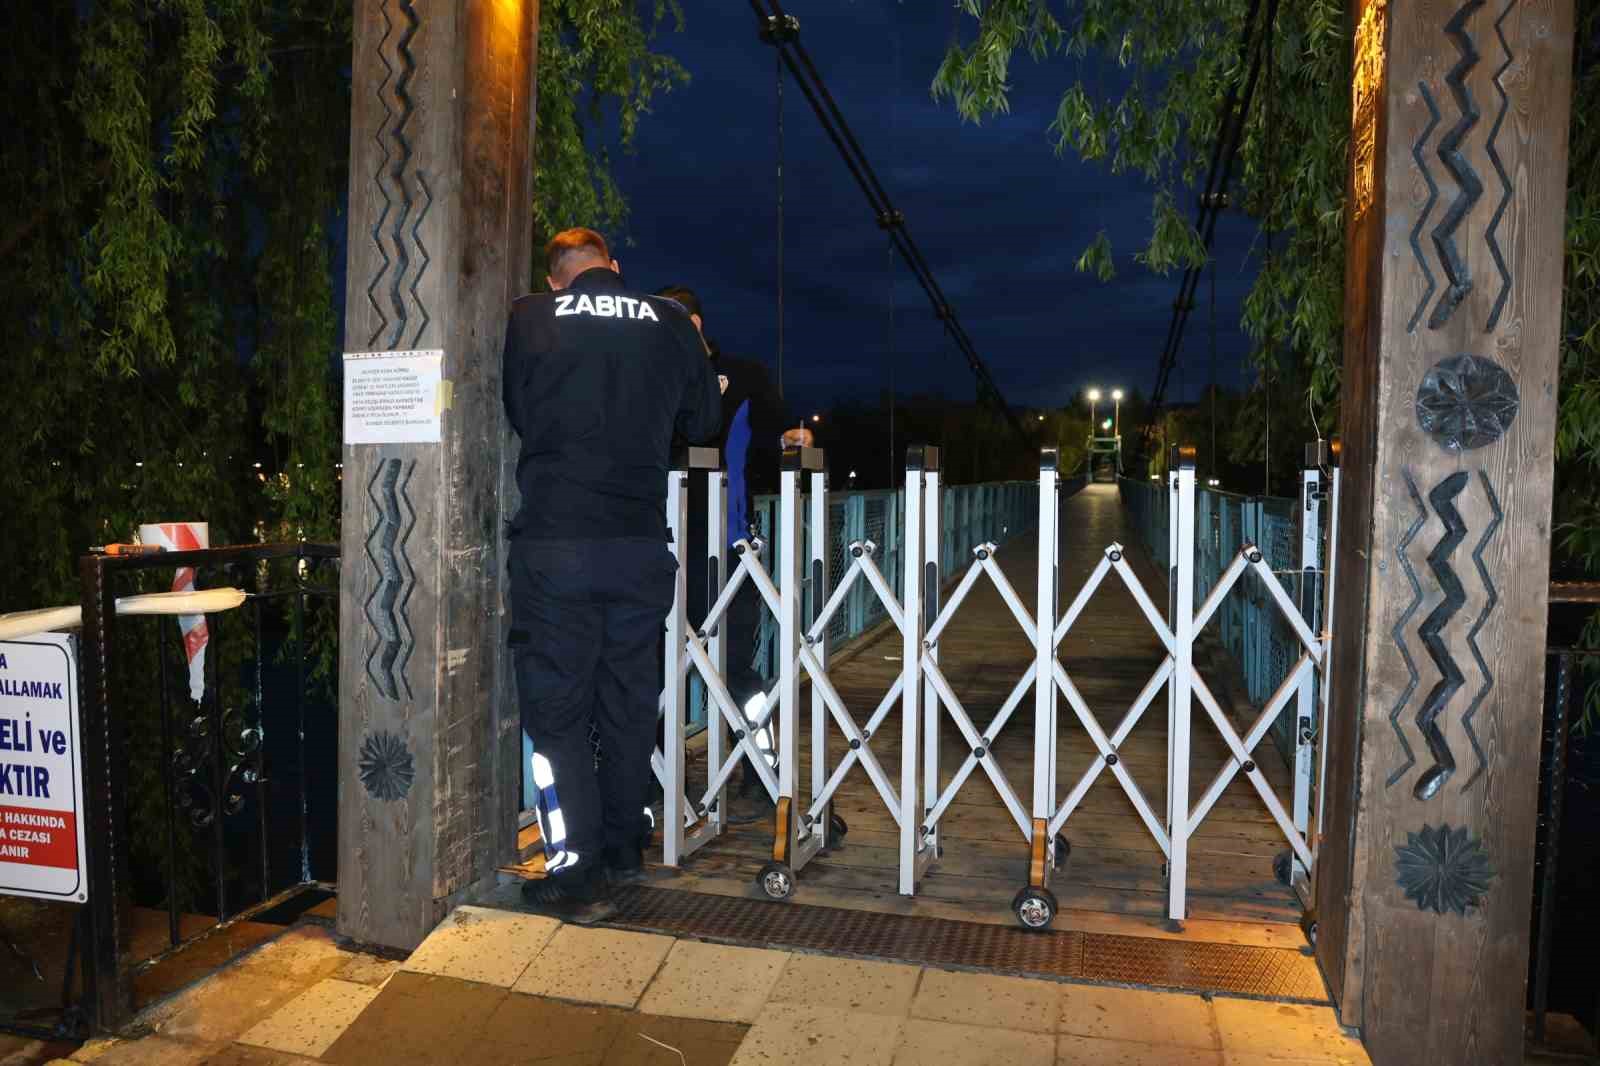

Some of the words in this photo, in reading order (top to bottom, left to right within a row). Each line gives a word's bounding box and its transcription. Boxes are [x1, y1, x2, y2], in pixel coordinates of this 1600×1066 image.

[555, 294, 659, 321] ZABITA
[0, 653, 7, 669] A
[39, 729, 66, 755] ve
[0, 763, 50, 798] KTIR
[5, 812, 65, 828] HAKKINDA
[9, 829, 51, 844] CEZASI
